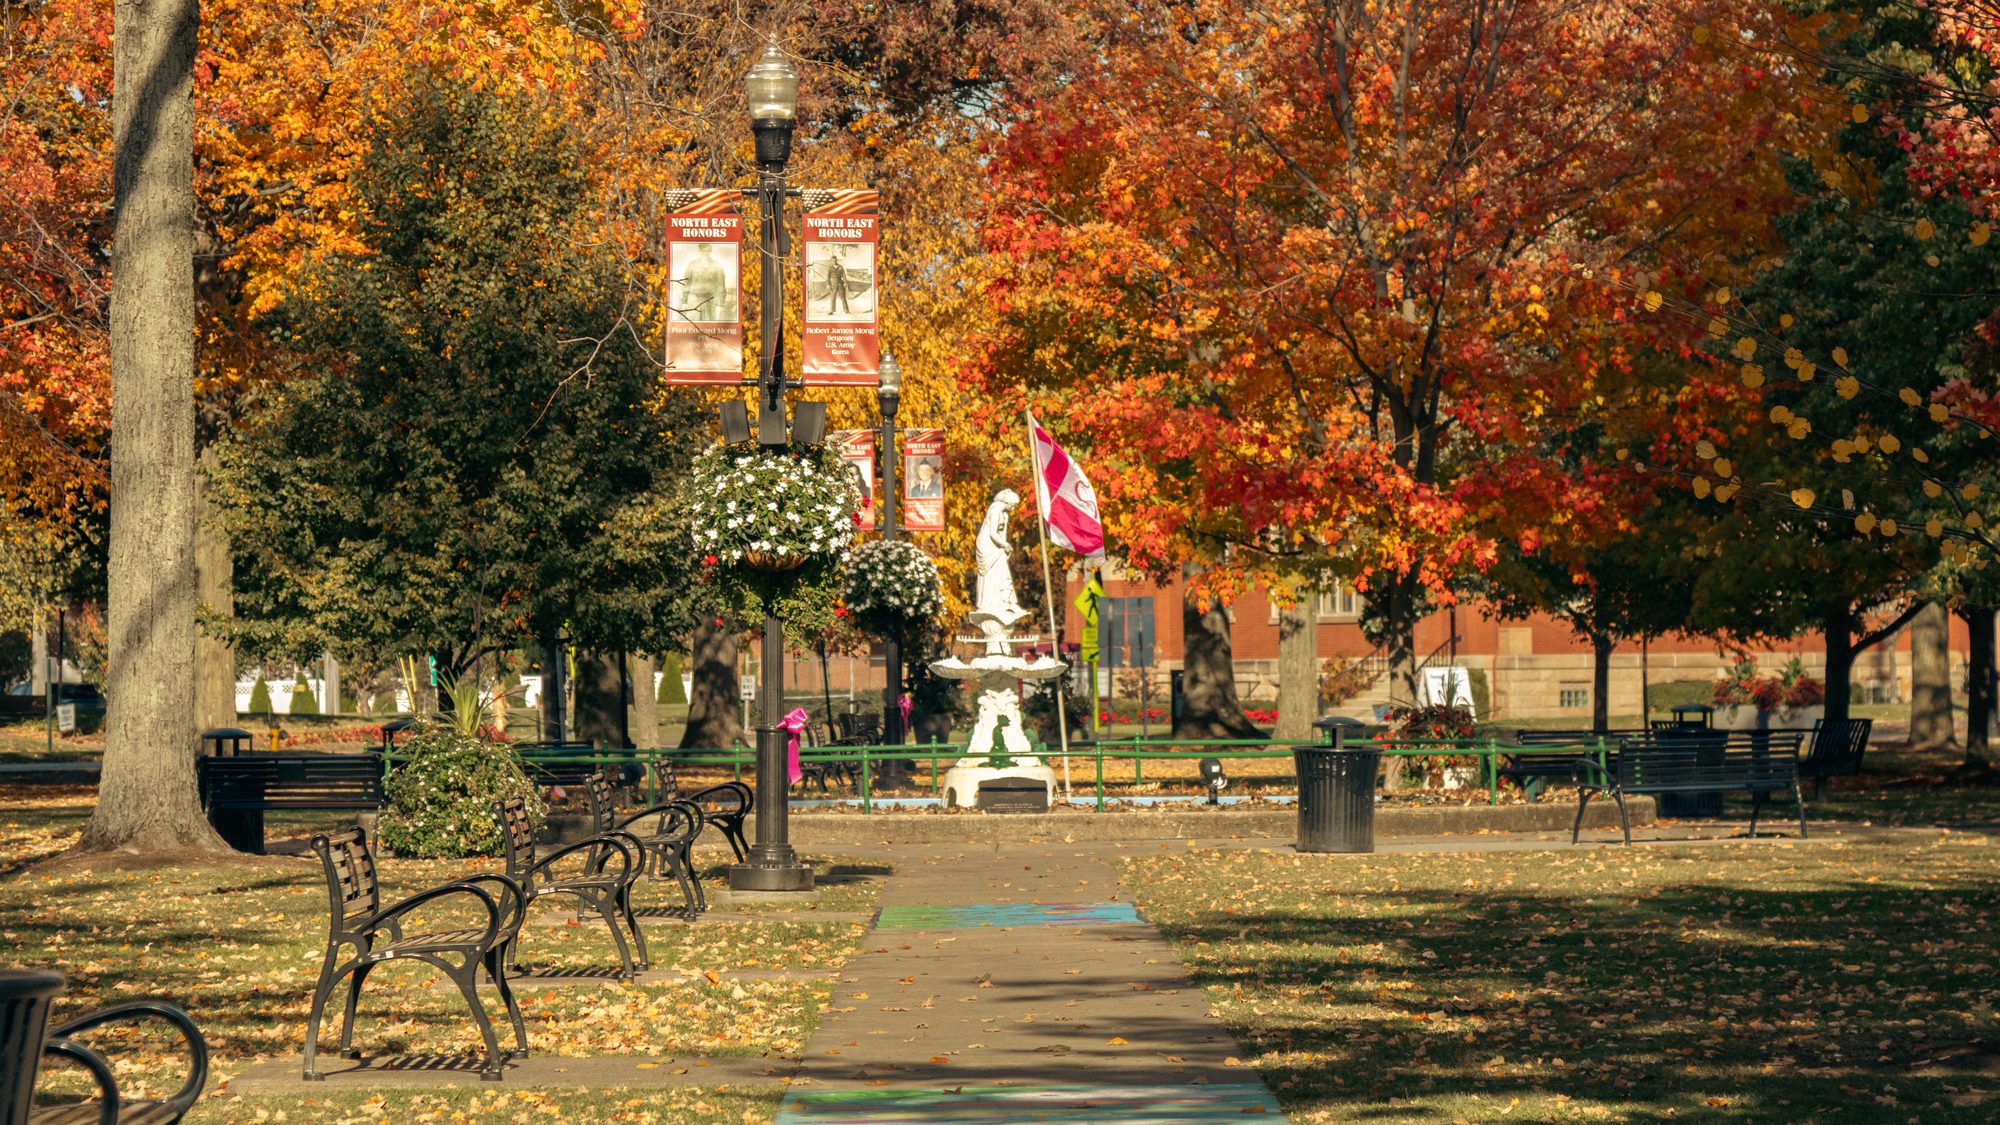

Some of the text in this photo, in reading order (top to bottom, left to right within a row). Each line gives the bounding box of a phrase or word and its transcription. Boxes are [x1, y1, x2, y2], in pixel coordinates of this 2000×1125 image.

[671, 217, 738, 228] NORTH EAST
[806, 217, 874, 228] NORTH EAST
[682, 228, 727, 238] HONORS
[818, 228, 863, 238] HONORS
[717, 327, 737, 335] Mong
[854, 327, 875, 335] Mong
